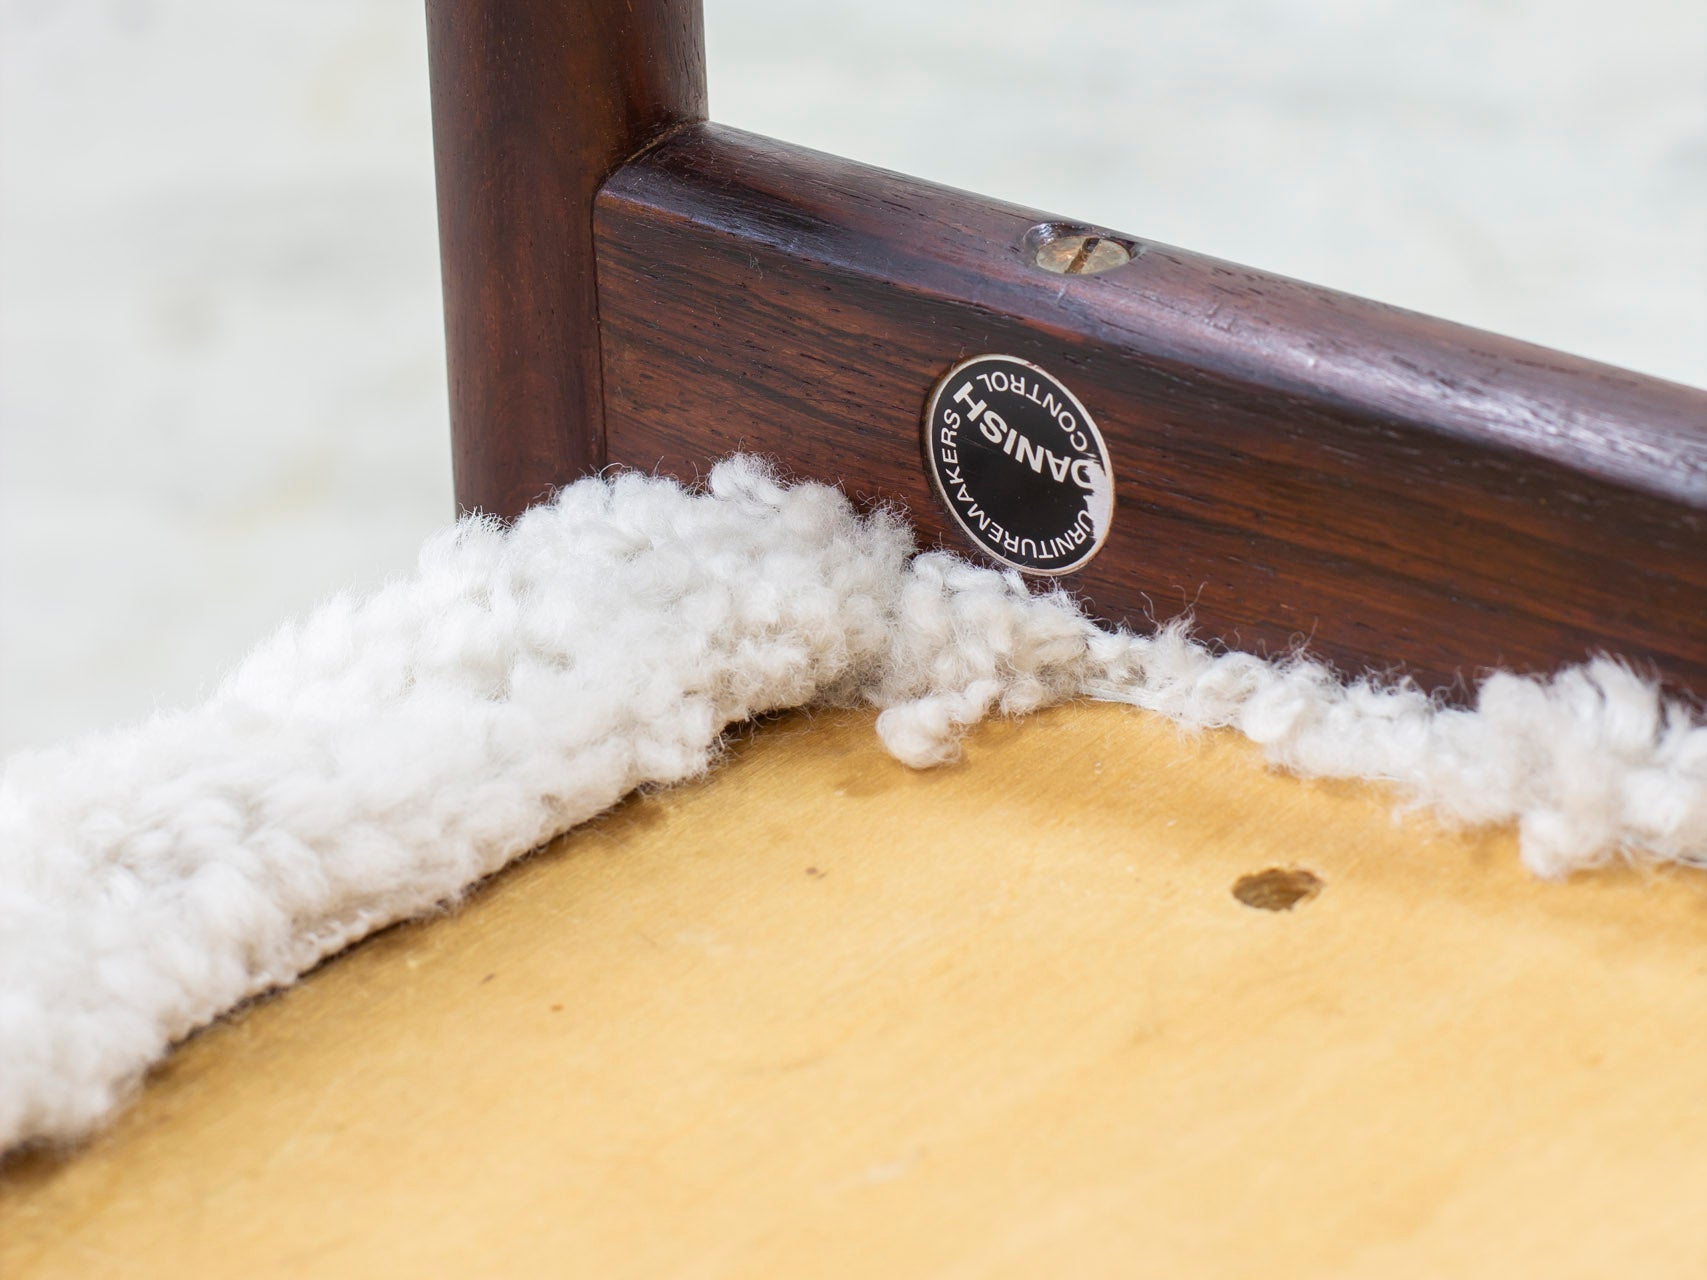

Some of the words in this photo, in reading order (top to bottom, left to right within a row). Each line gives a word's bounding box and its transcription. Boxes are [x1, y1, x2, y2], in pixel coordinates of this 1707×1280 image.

[953, 381, 1095, 490] DANISH
[976, 371, 1088, 452] CONTROL
[940, 409, 1094, 559] URNITUREMAKERS
